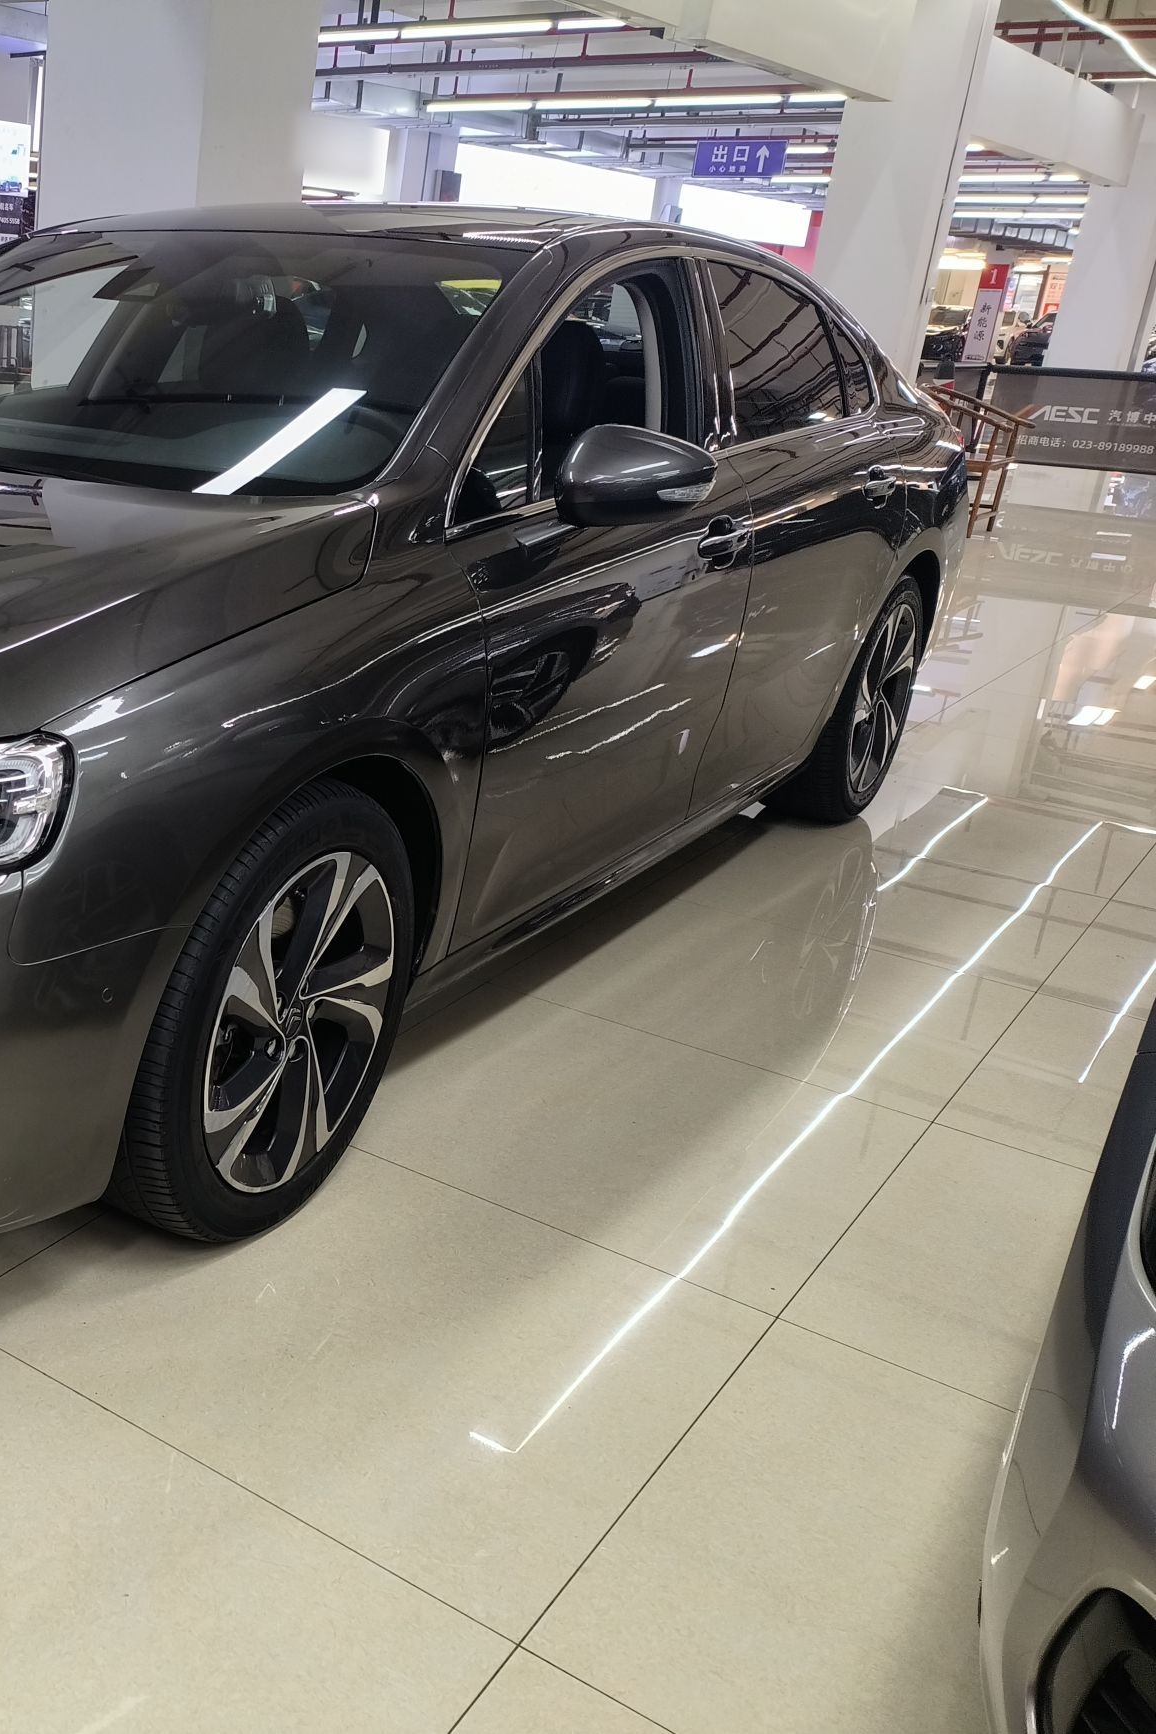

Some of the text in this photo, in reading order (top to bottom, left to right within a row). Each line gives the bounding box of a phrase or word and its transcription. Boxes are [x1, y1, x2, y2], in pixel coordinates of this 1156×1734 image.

[712, 145, 750, 163] 出口
[709, 165, 746, 173] 小心地滑
[989, 268, 999, 285] 1
[973, 302, 993, 342] 新能源
[1072, 440, 1155, 455] 023-89189988
